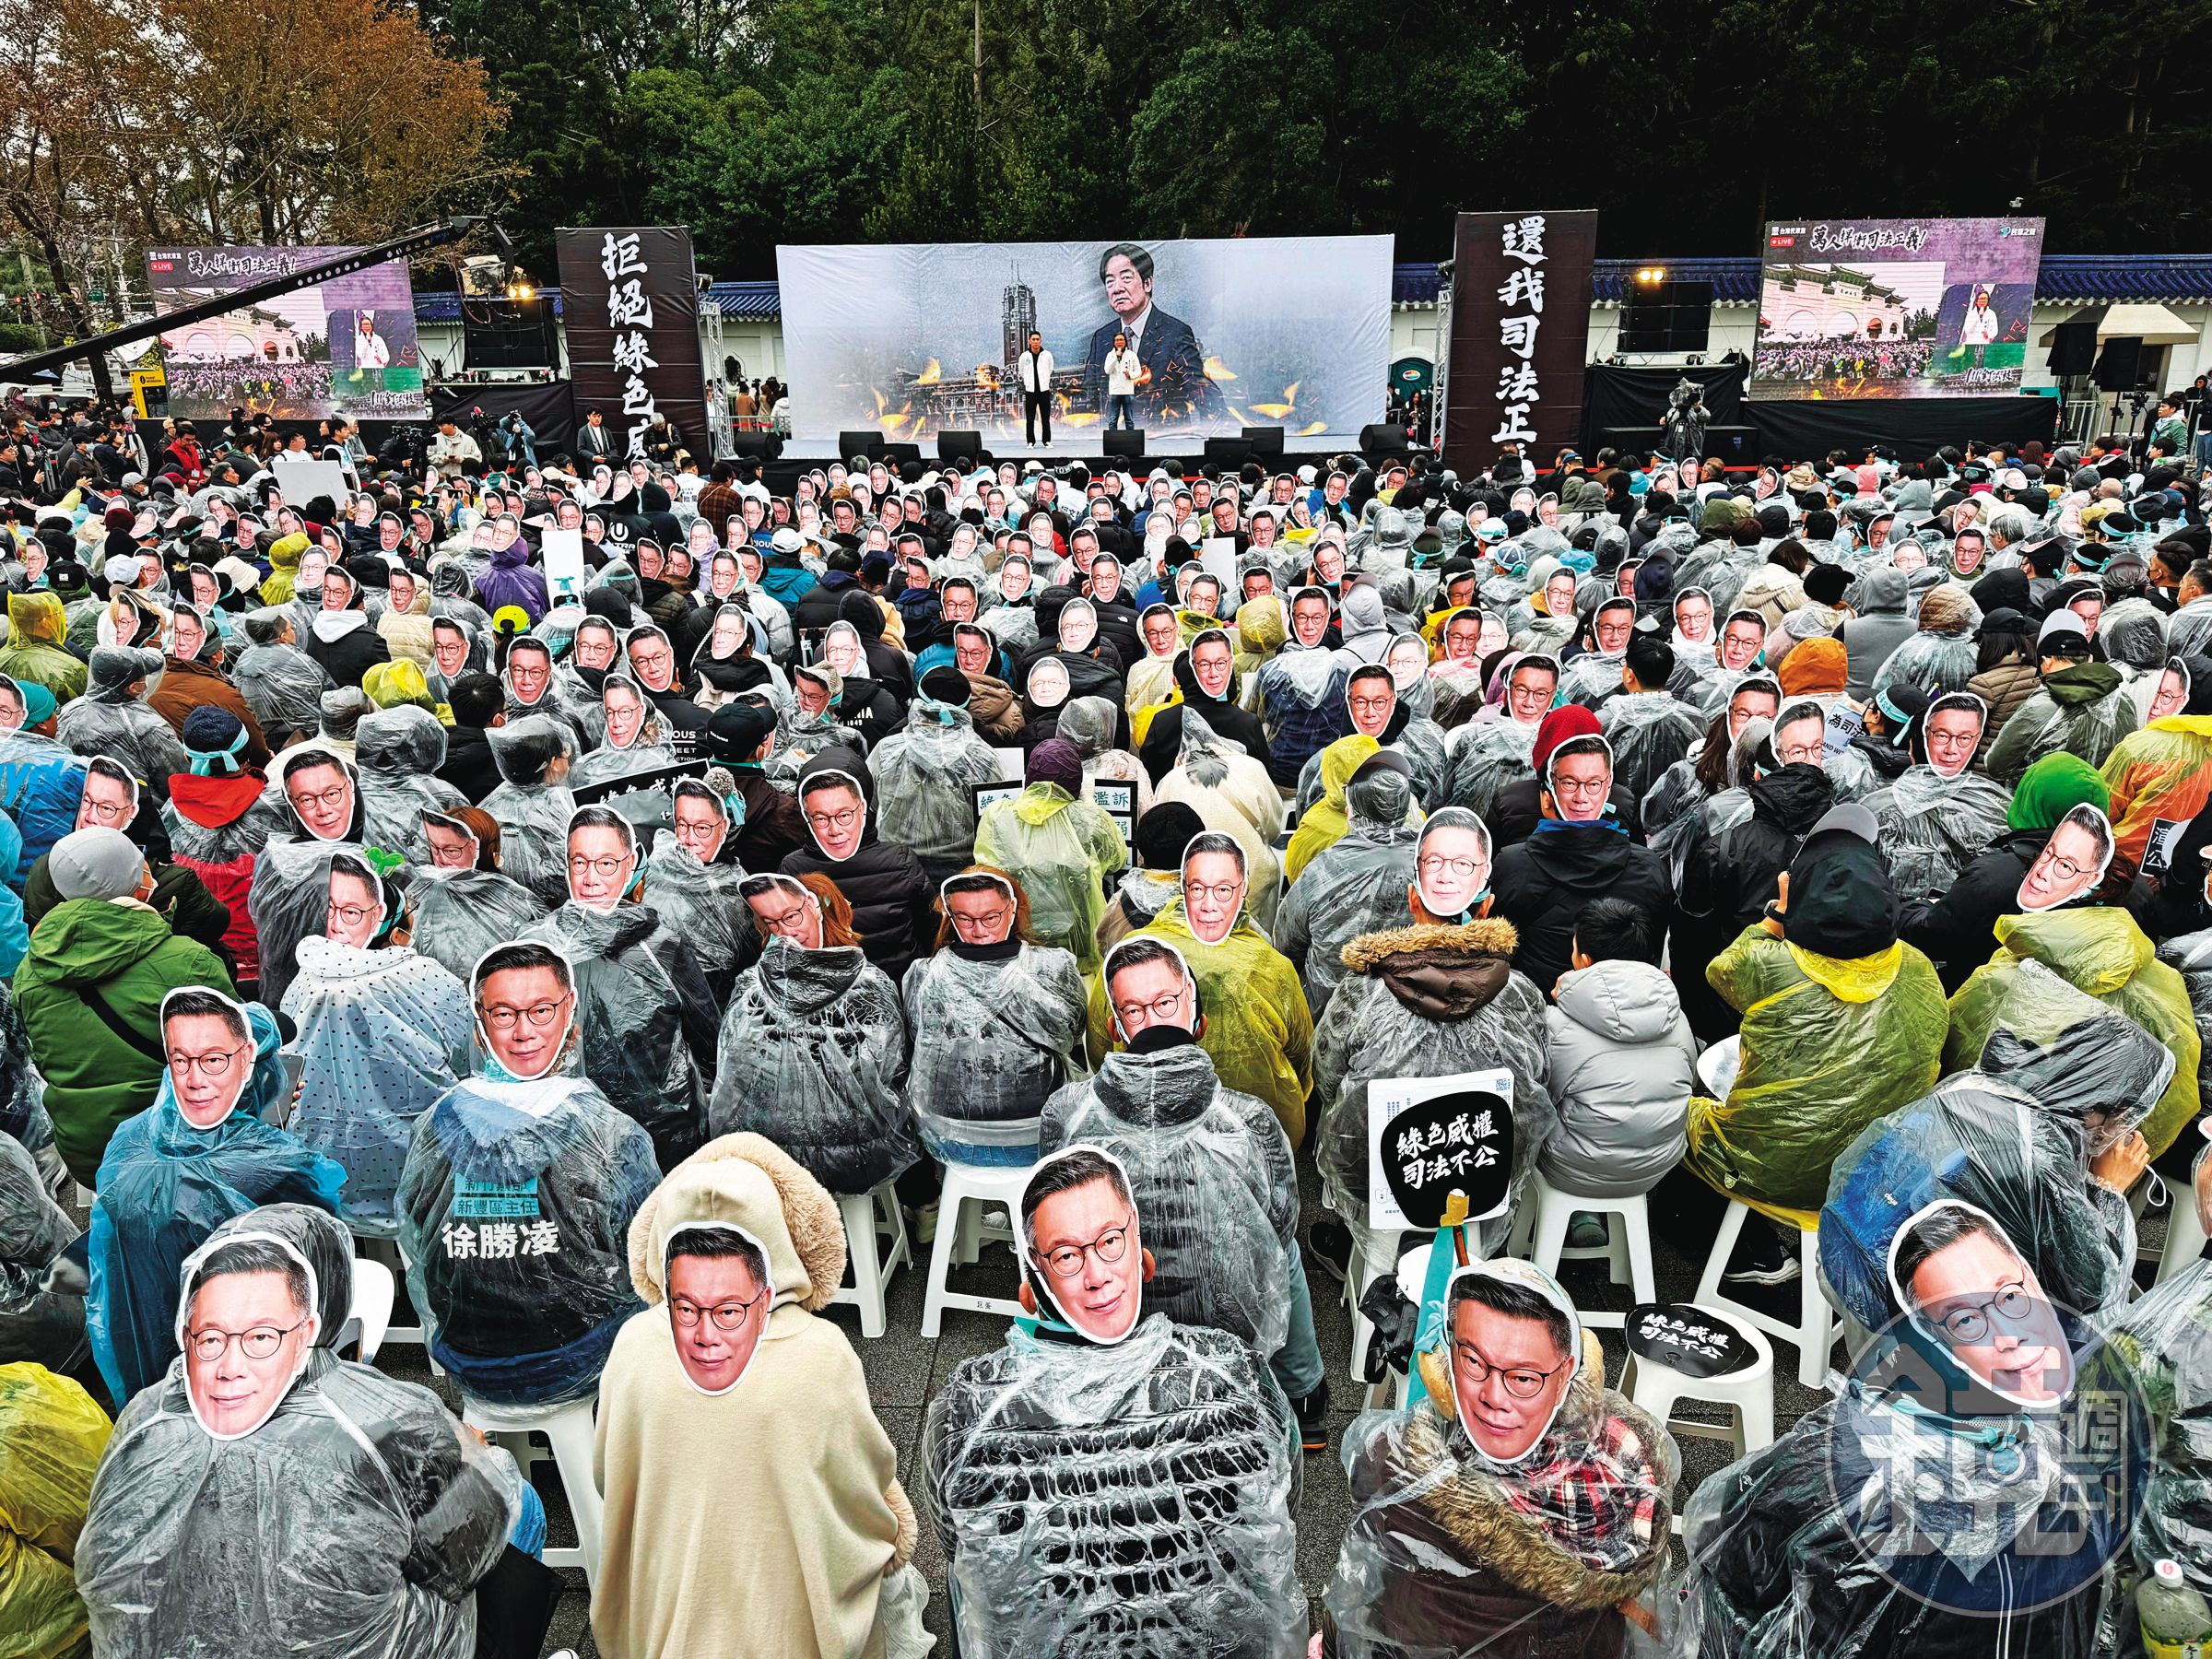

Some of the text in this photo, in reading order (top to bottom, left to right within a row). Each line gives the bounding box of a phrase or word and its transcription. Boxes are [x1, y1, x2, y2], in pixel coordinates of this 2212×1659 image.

[672, 730, 697, 739] OUS
[1093, 791, 1130, 808] 濫訴
[1395, 1110, 1500, 1162] 綠色威權
[1402, 1145, 1500, 1190] 司法不公
[457, 1199, 537, 1215] 新豐區主任
[441, 1219, 561, 1260] 徐勝凌
[1639, 1325, 1724, 1359] 司法不公
[1641, 1313, 1729, 1349] 綠色威權
